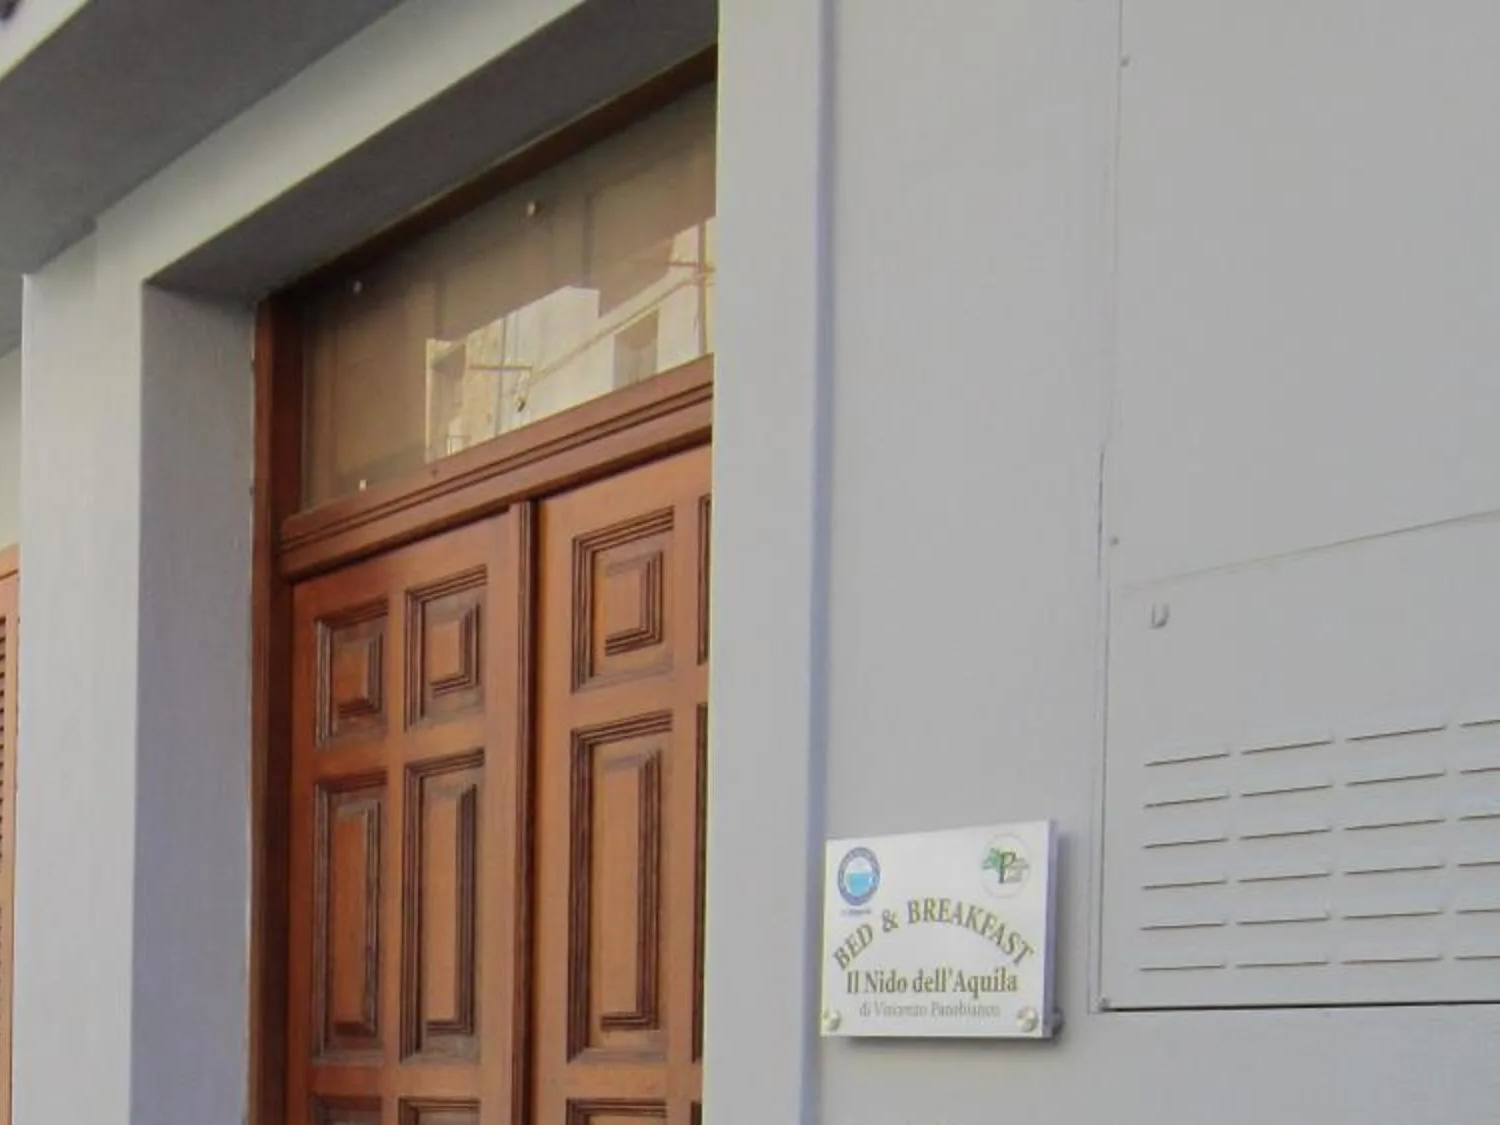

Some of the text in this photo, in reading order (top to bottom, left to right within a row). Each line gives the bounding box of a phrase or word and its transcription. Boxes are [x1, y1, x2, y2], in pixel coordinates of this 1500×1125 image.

[833, 897, 1034, 969] BED & BREAKFAST
[846, 966, 1018, 998] Il Nido dell'Aquila
